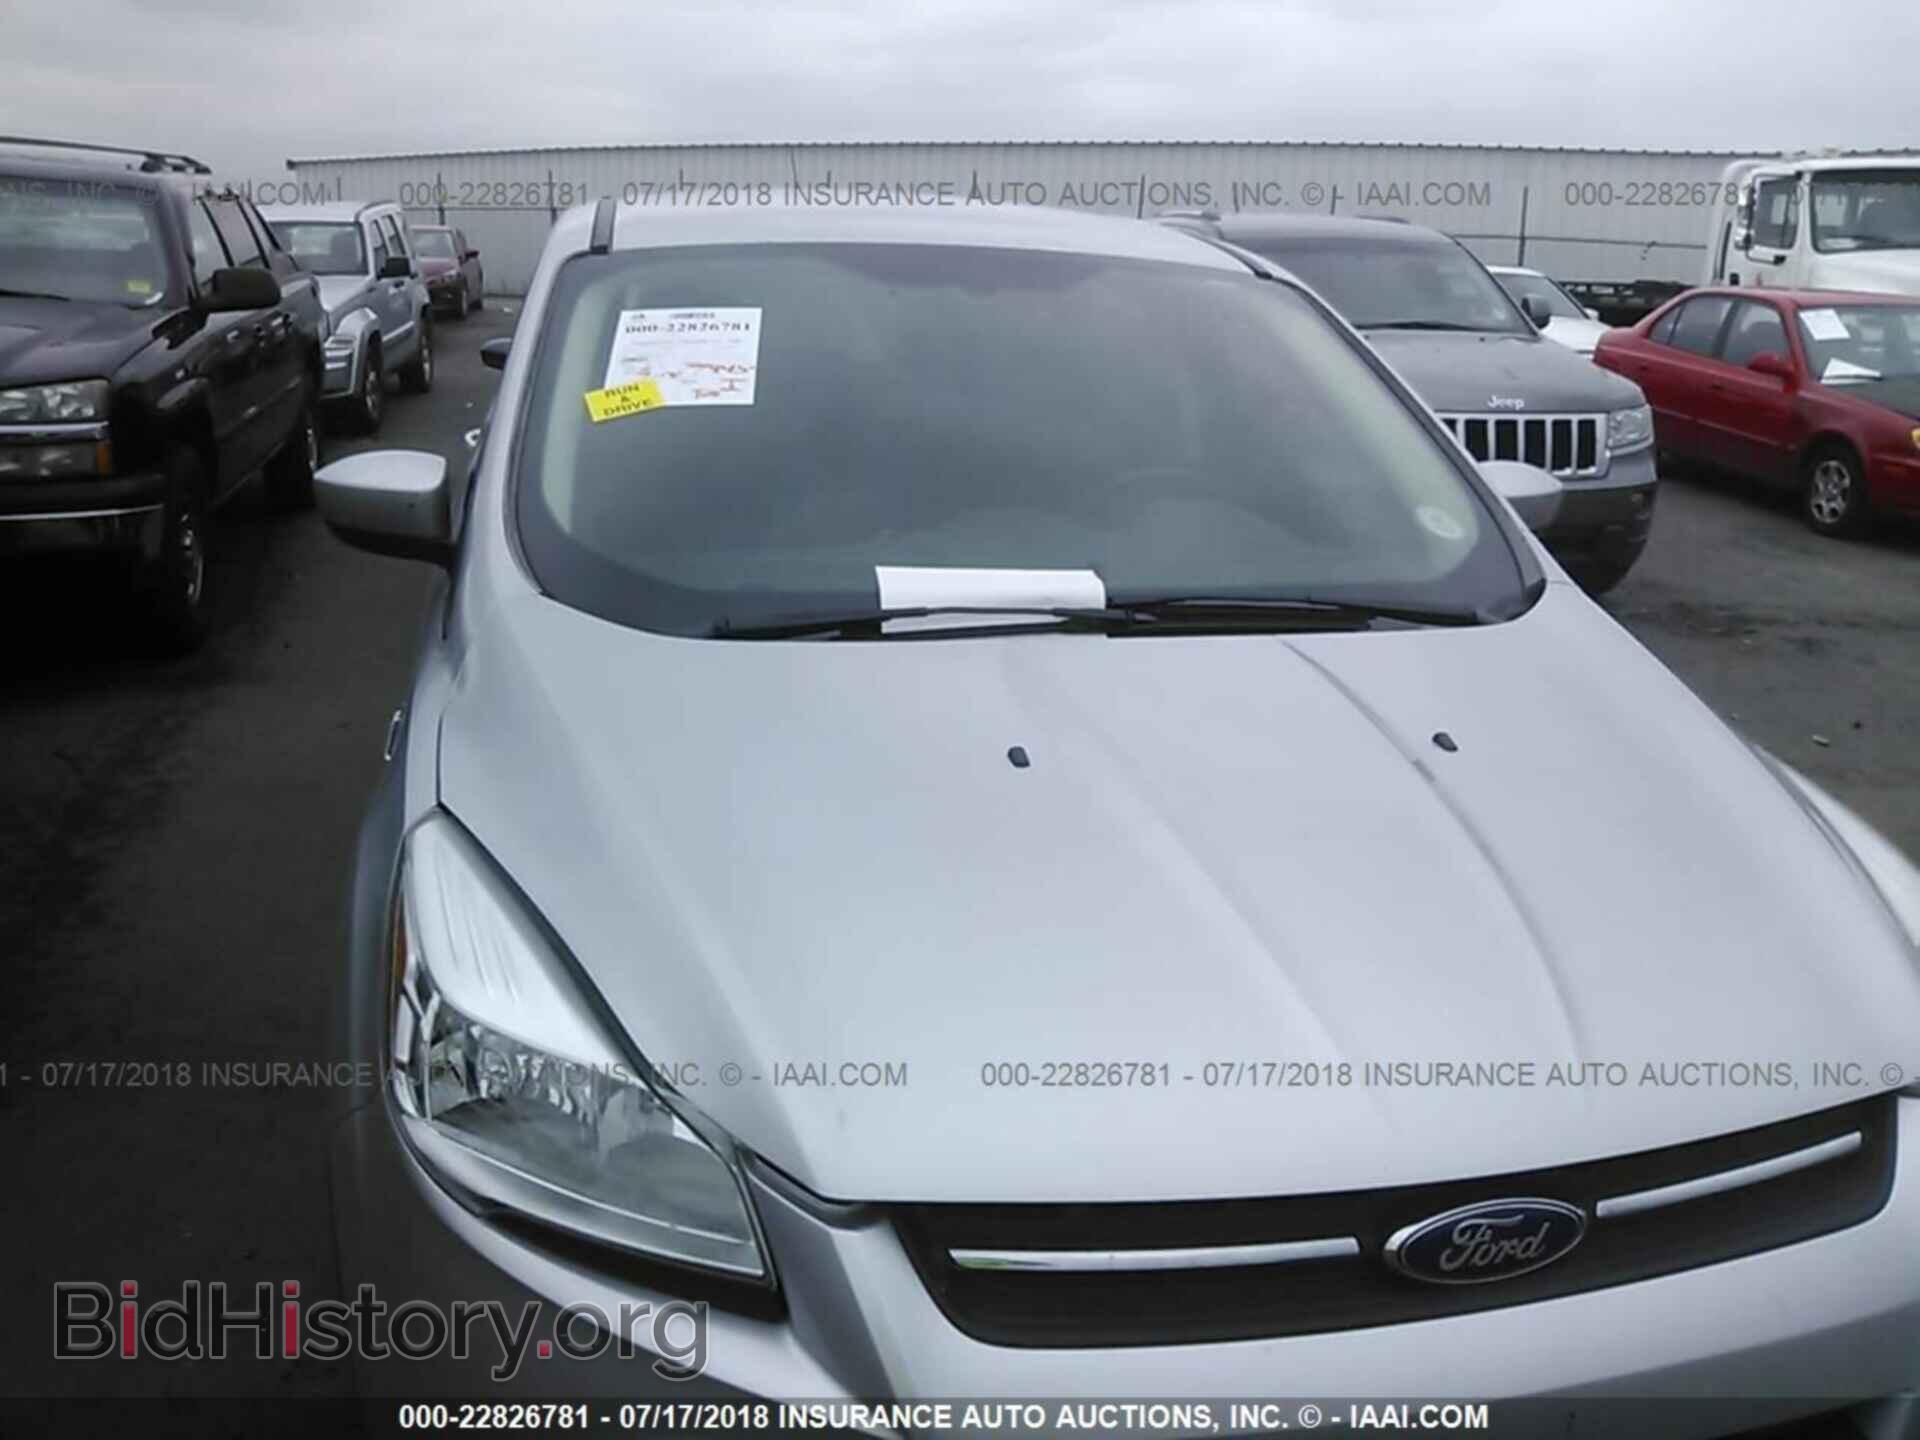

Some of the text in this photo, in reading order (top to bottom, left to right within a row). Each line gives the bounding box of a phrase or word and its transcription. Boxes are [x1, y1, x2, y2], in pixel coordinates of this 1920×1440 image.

[603, 382, 641, 398] RUN
[603, 398, 651, 417] DRIVE
[1488, 395, 1525, 410] Jeep
[1439, 1214, 1550, 1271] Ford
